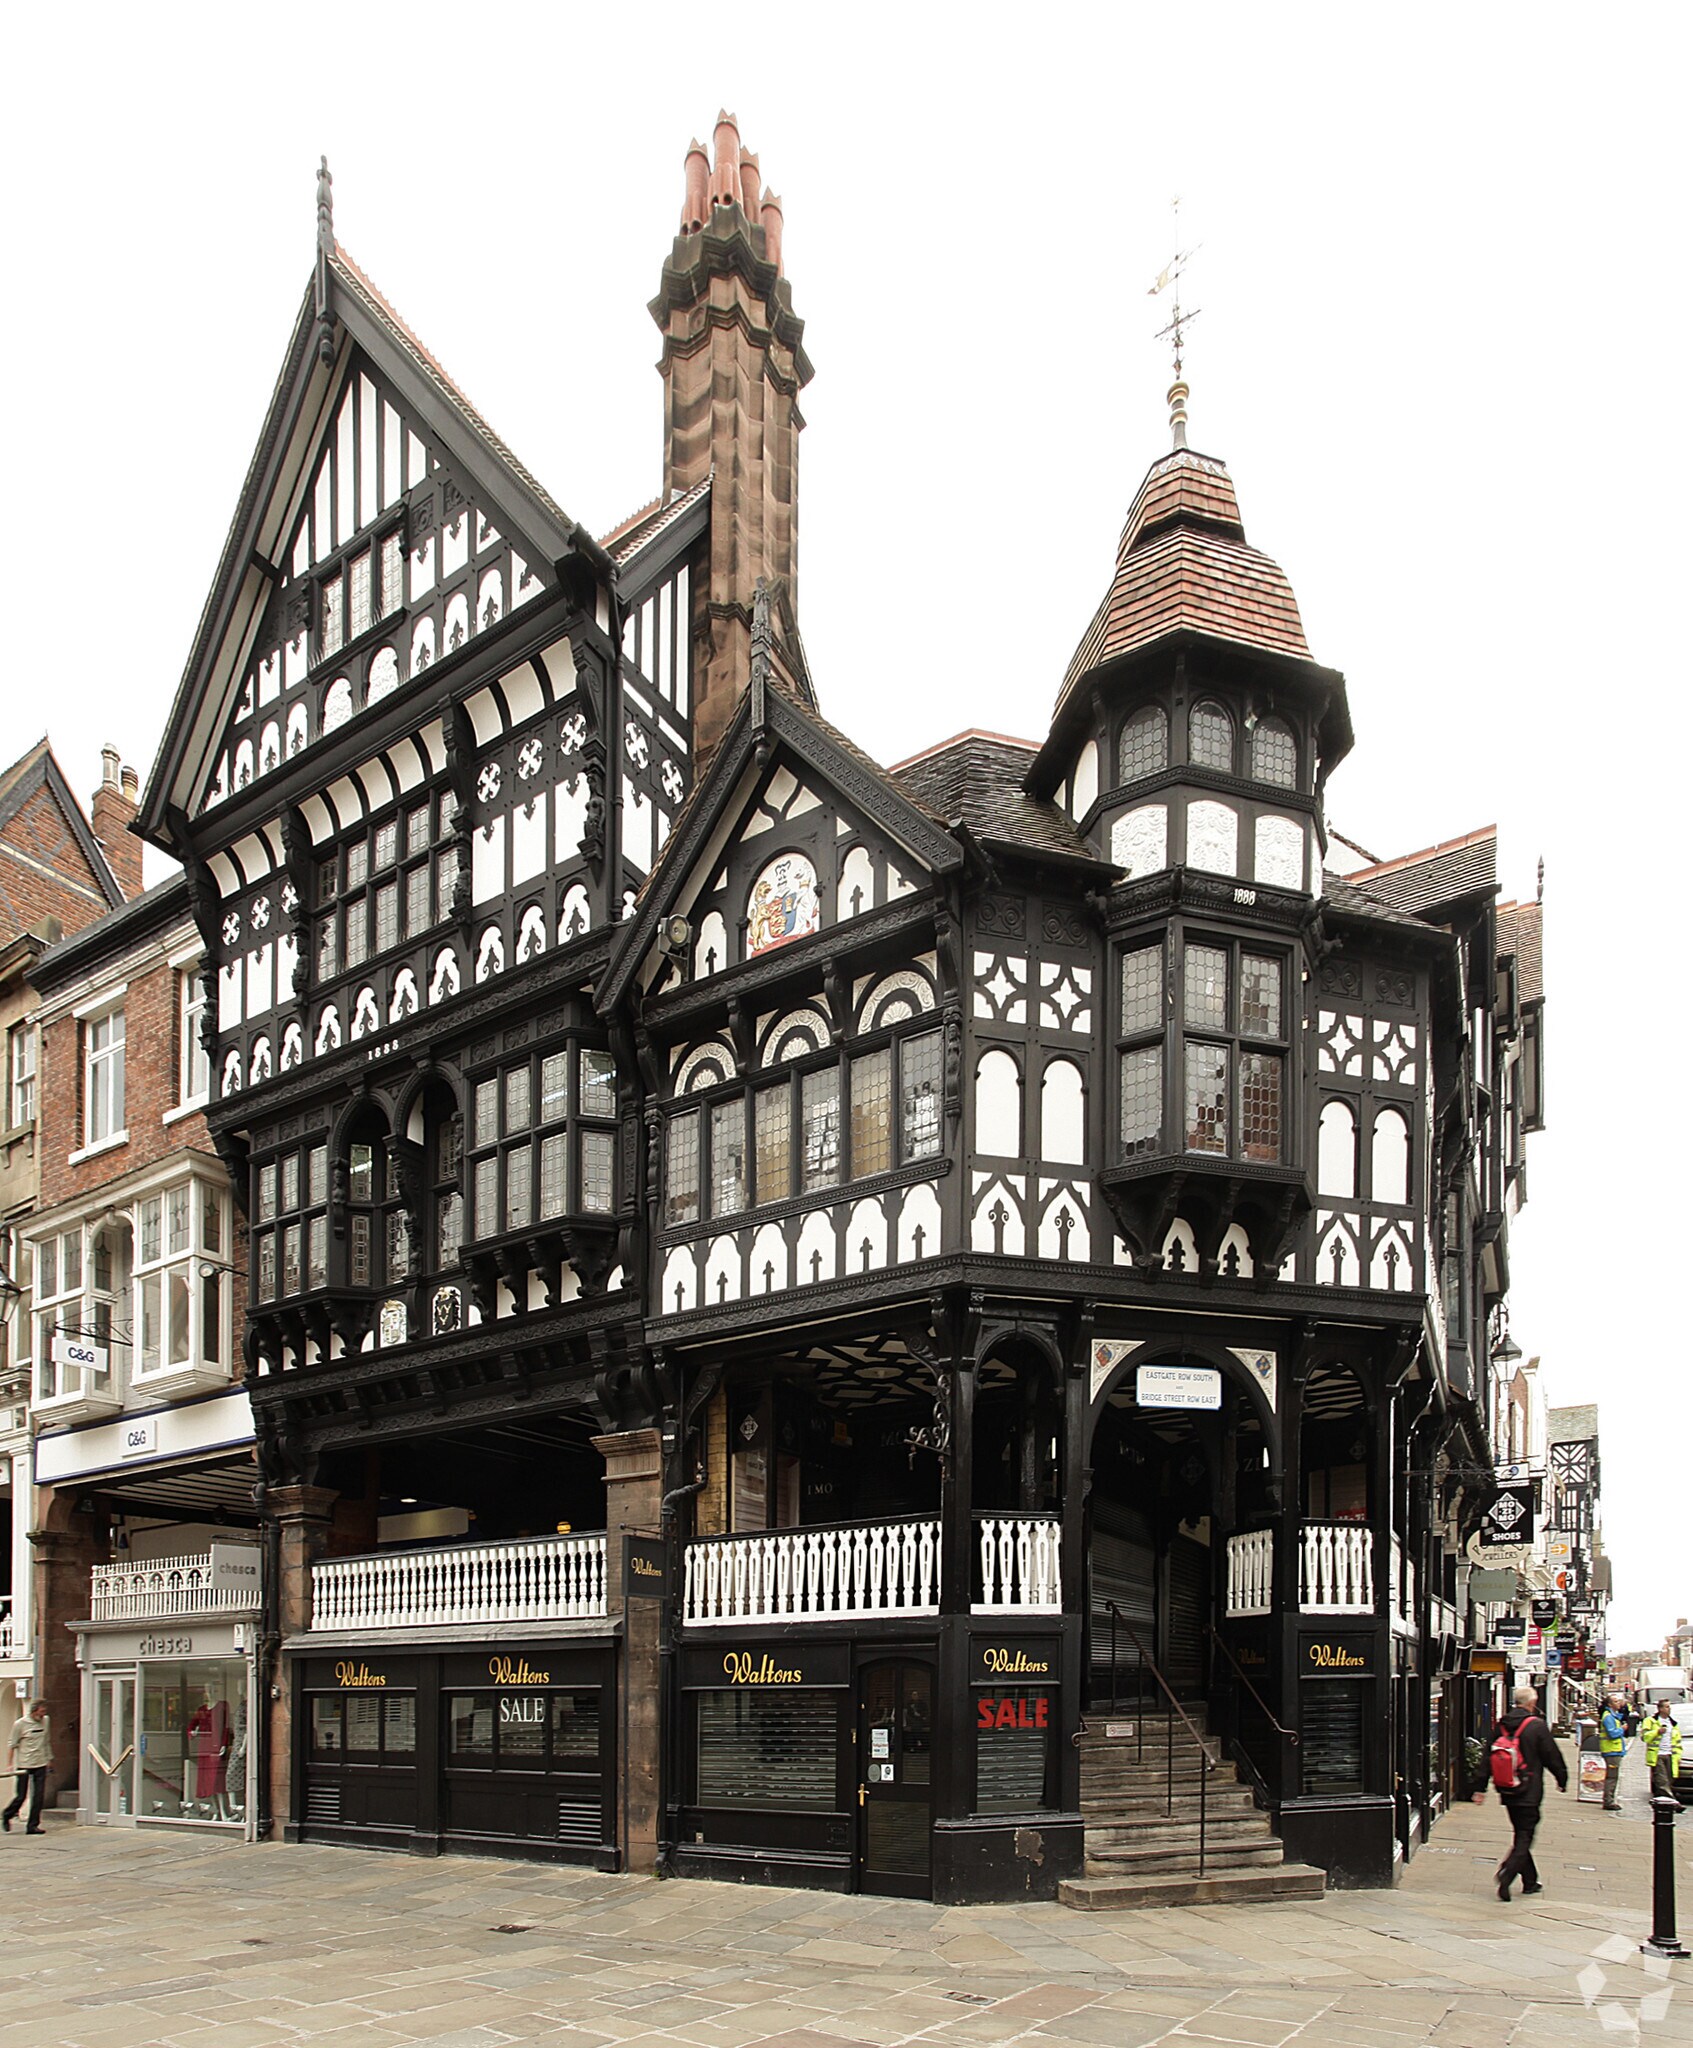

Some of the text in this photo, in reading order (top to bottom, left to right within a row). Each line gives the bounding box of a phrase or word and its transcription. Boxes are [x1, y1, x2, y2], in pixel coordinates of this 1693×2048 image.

[1233, 888, 1256, 906] 1888
[367, 1039, 399, 1060] 1888
[68, 1346, 95, 1363] C&G
[1145, 1371, 1213, 1382] EASTGATE ROW SOUTH
[1141, 1393, 1217, 1404] BRIDGE STREET ROW EAST
[127, 1430, 146, 1447] C&G
[1491, 1531, 1522, 1541] SHOES
[219, 1562, 257, 1575] chesca
[631, 1556, 662, 1577] Waltons
[139, 1634, 193, 1655] chesca
[983, 1648, 1049, 1673] Waltons
[1309, 1644, 1365, 1667] Waltons
[335, 1660, 386, 1687] Waltons
[488, 1656, 550, 1685] Waltons
[723, 1651, 802, 1684] Waltons
[500, 1697, 545, 1723] SALE
[976, 1698, 1049, 1729] SALE
